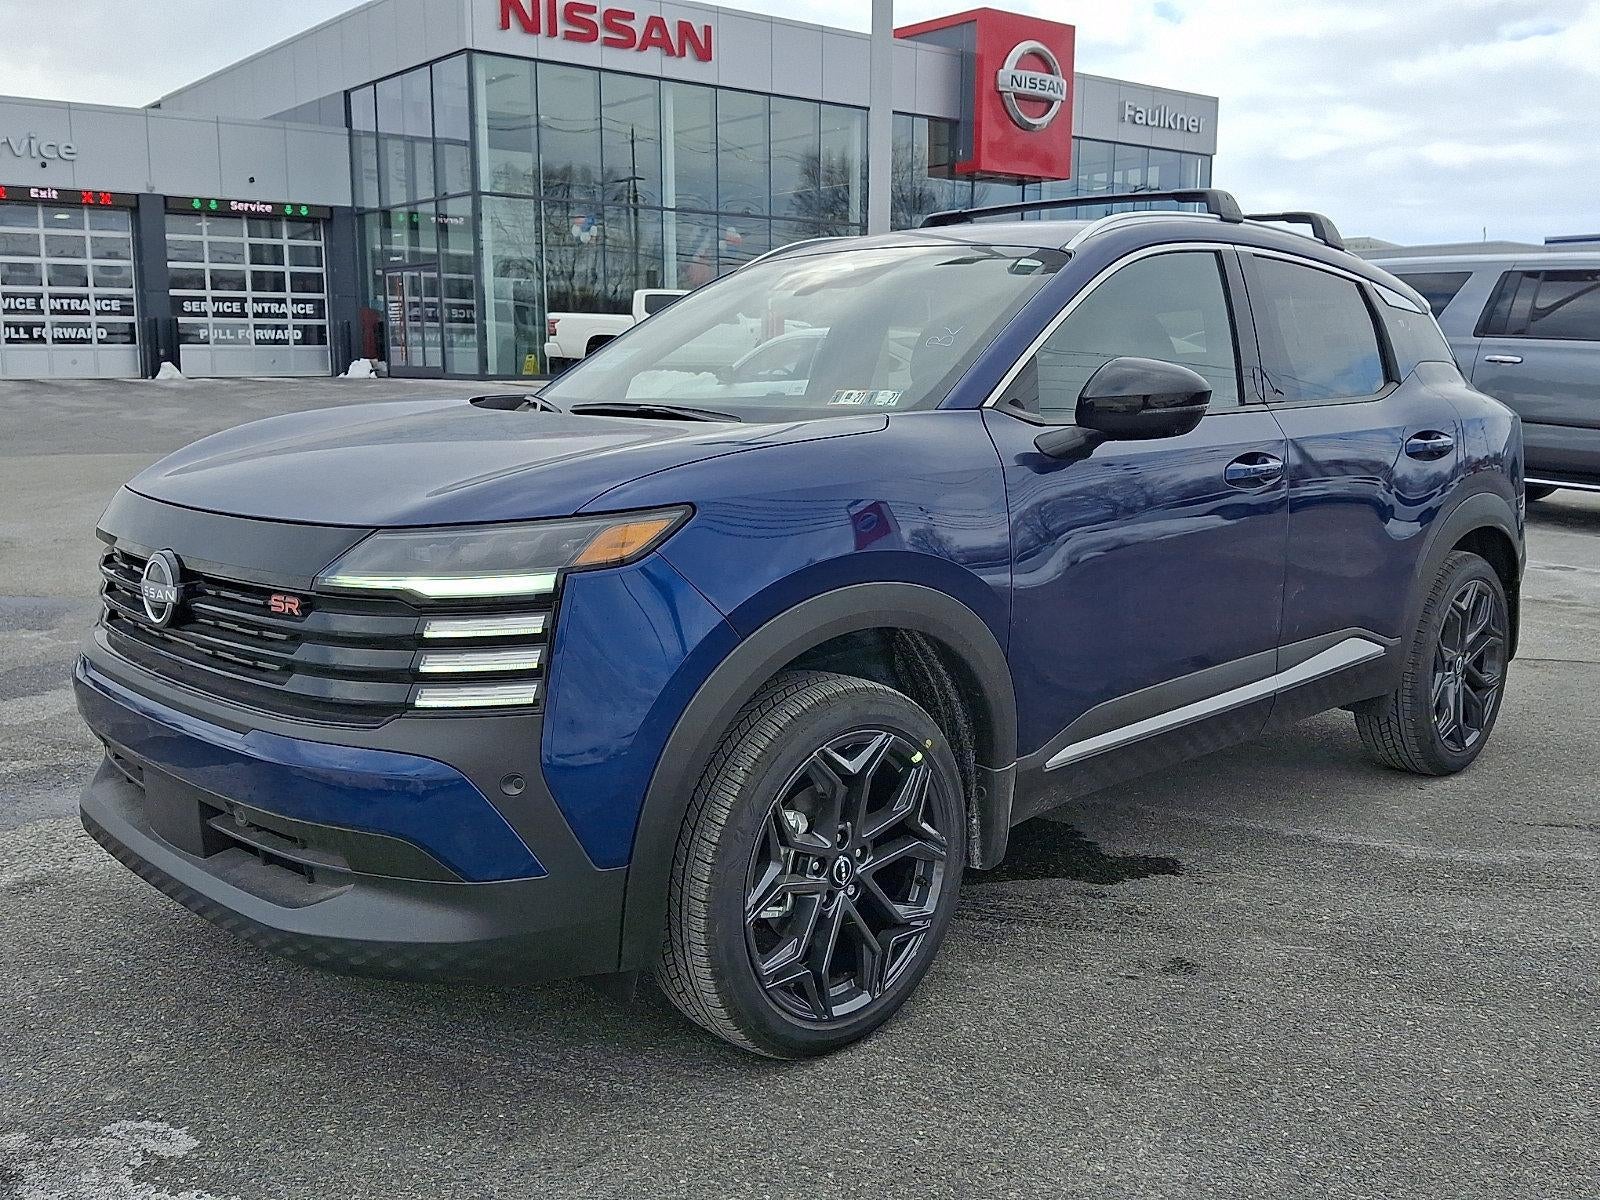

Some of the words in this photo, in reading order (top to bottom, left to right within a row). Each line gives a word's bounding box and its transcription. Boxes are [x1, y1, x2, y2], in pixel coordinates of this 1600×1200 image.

[499, 0, 713, 62] NISSAN
[1010, 74, 1064, 95] NISSAN
[1123, 100, 1206, 133] Faulkner
[29, 187, 58, 199] Exit
[230, 200, 273, 213] Service
[182, 300, 242, 313] SERVICE
[142, 585, 175, 601] SSAN
[269, 593, 302, 616] SR
